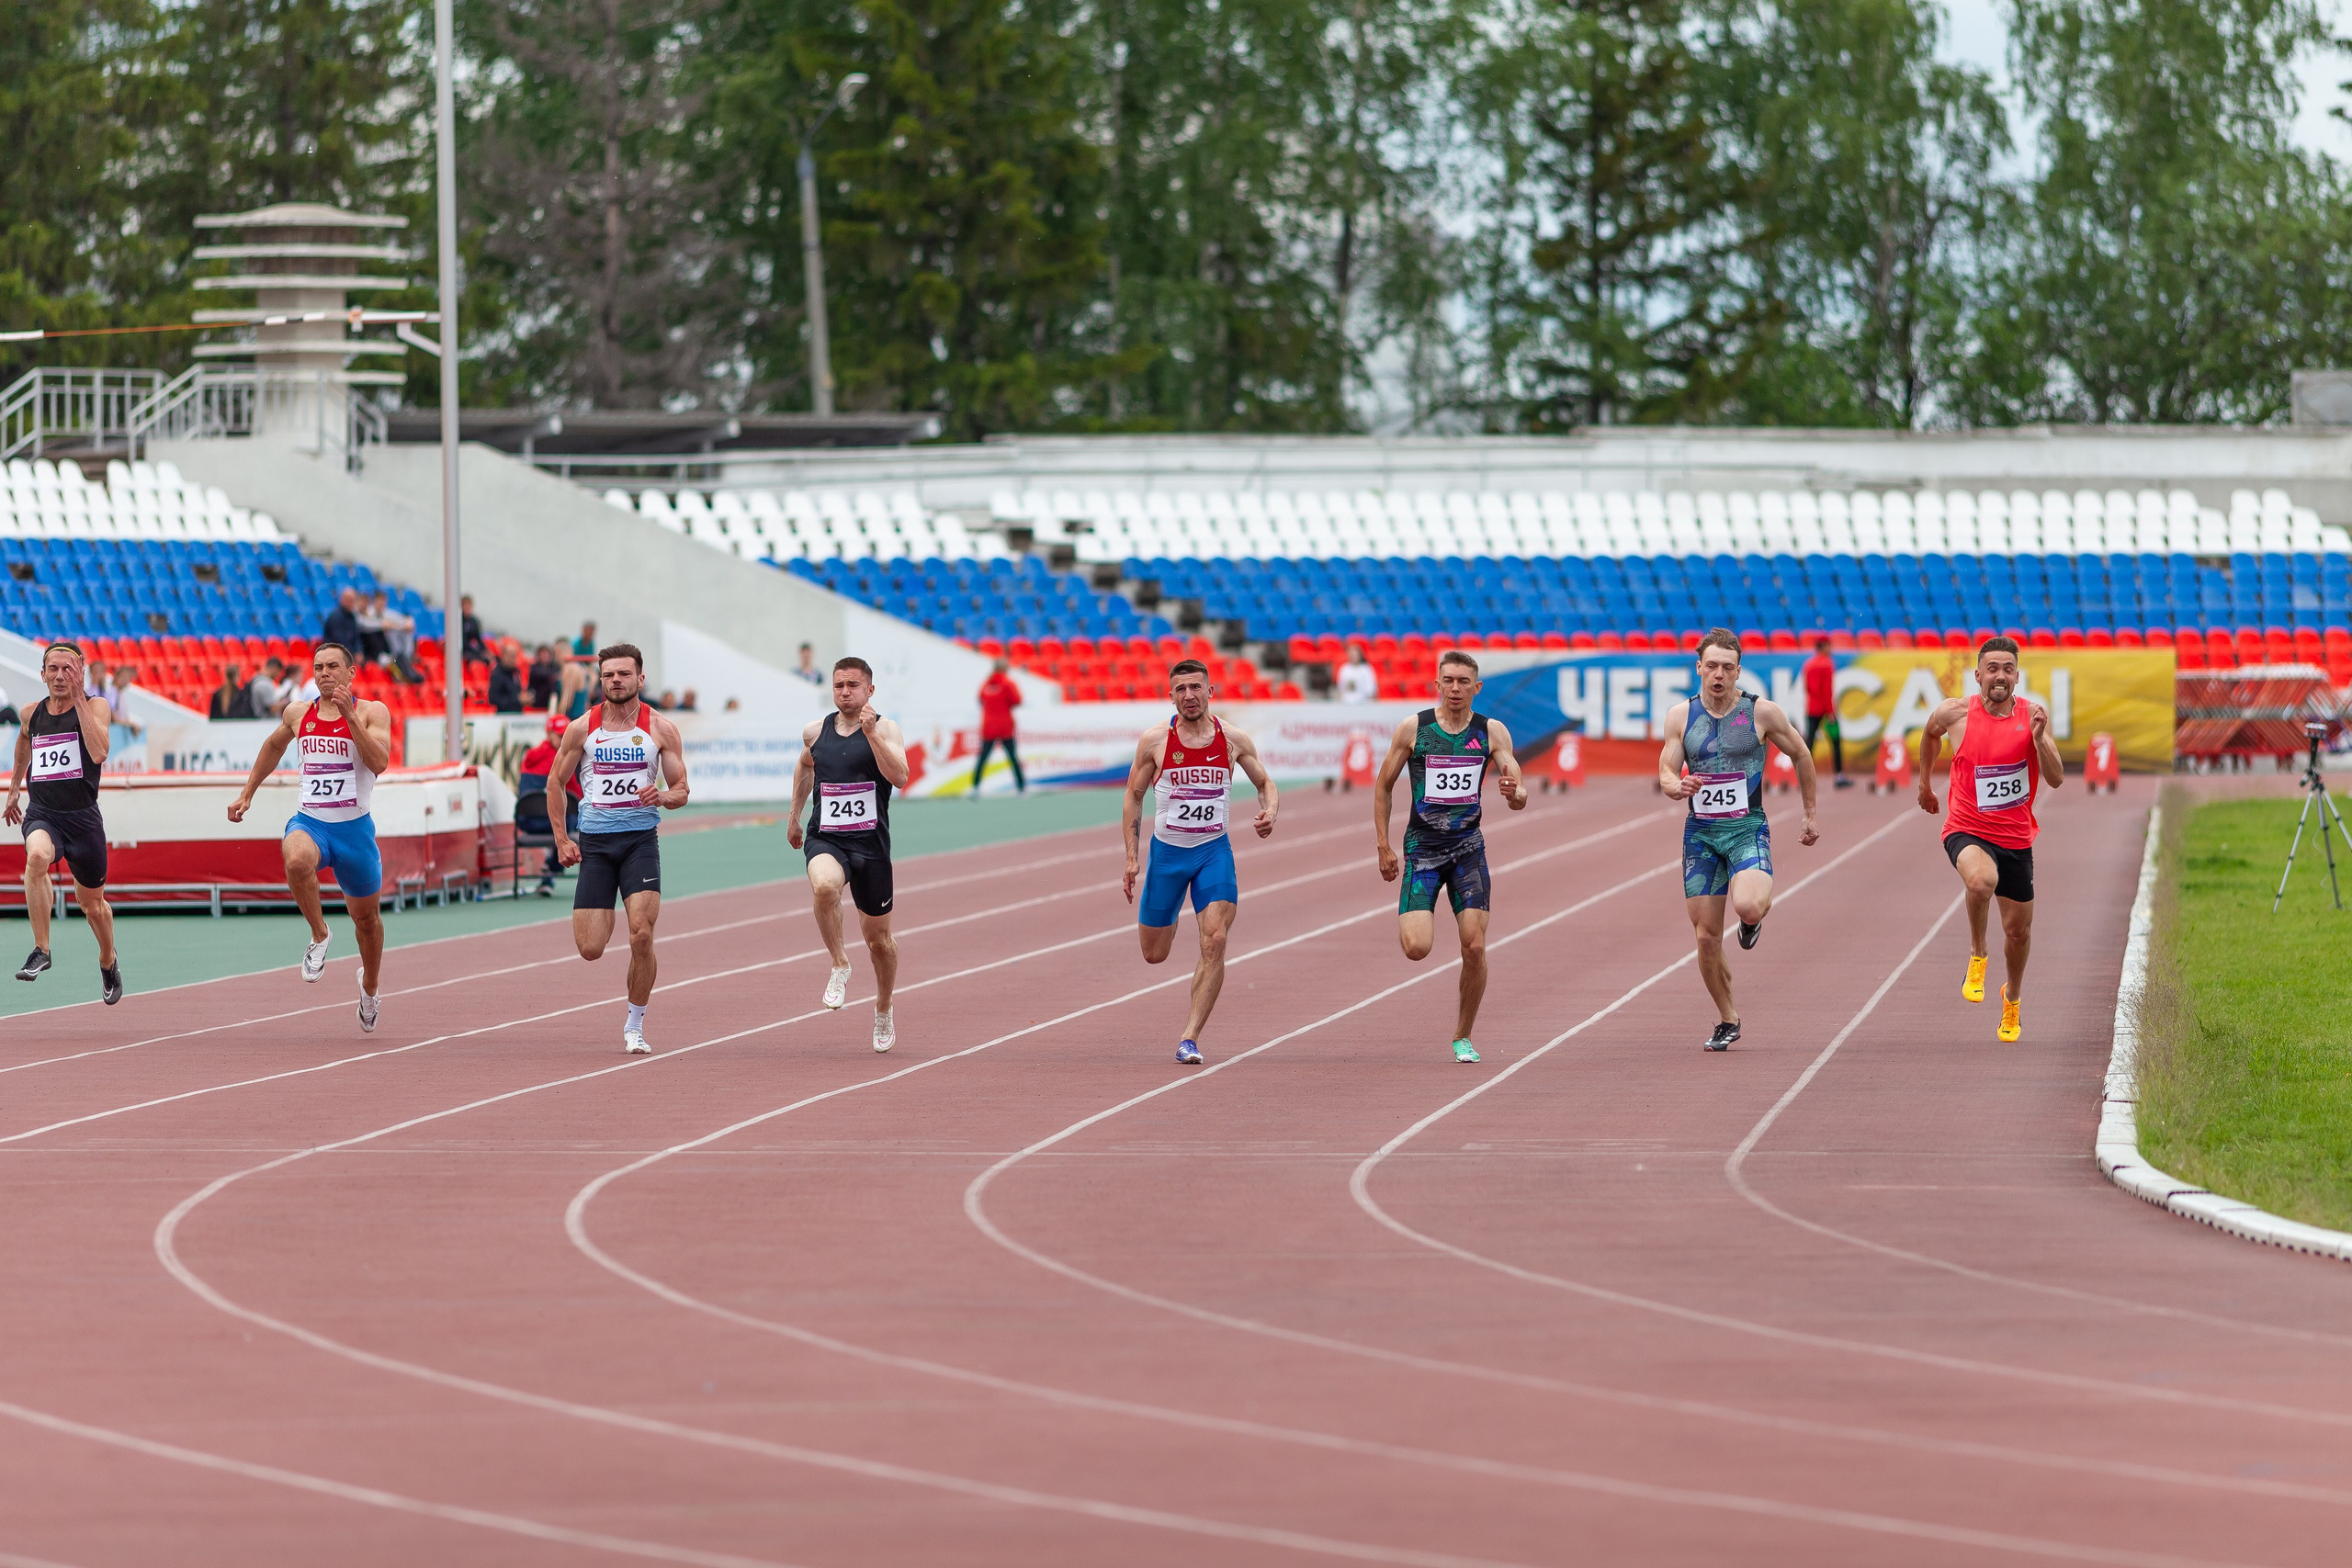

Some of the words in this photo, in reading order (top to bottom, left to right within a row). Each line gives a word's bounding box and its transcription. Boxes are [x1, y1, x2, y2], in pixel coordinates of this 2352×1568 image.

[1556, 664, 2073, 742] ЧЕБКСАЫ
[302, 738, 349, 758] RUSSIA
[594, 747, 645, 761] RUSSIA
[40, 750, 71, 768] 196
[1883, 742, 1906, 773] 3
[1170, 769, 1224, 786] RUSSIA
[1435, 773, 1473, 791] 335
[311, 779, 345, 796] 257
[602, 778, 639, 796] 266
[1986, 778, 2022, 798] 258
[1702, 788, 1736, 807] 245
[830, 800, 865, 818] 243
[1178, 804, 1215, 821] 248
